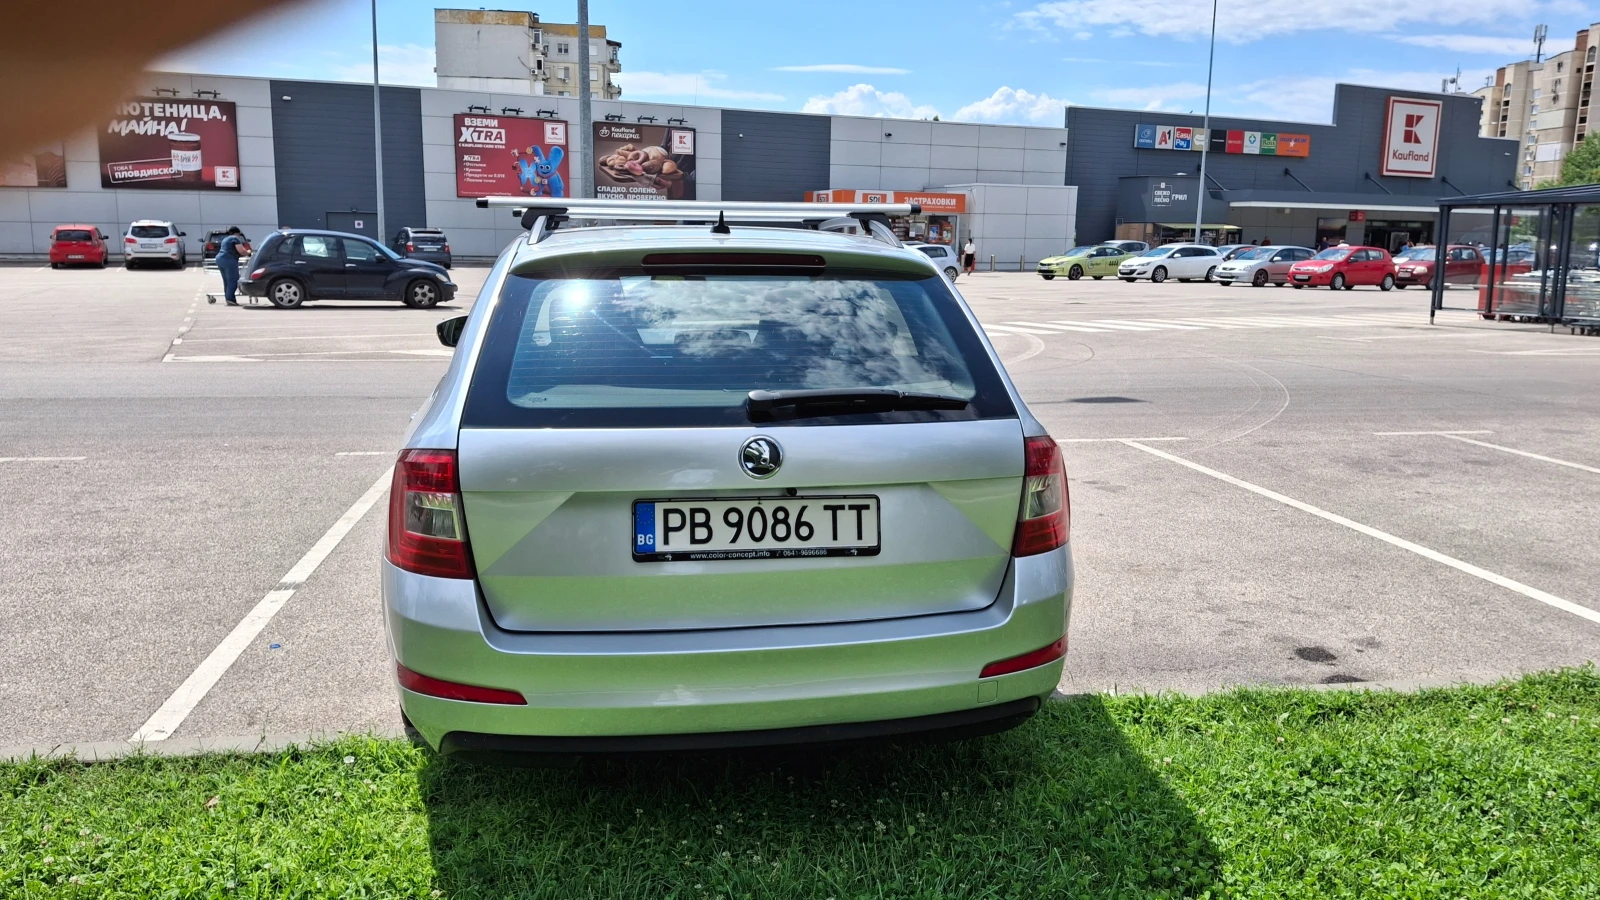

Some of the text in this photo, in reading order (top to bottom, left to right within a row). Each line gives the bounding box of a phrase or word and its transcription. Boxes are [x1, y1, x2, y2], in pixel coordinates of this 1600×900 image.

[107, 116, 187, 137] МАЙНА!
[464, 117, 498, 127] ВЗЕМИ
[459, 127, 504, 143] XTRA
[611, 132, 640, 140] пекарна
[1158, 129, 1172, 145] A1
[1176, 131, 1191, 140] Easy
[1175, 139, 1187, 147] Pay
[1392, 149, 1430, 162] Kaufland
[597, 185, 658, 194] СЛАДКО. СОЛЕНО.
[868, 195, 881, 203] SDI
[904, 196, 956, 206] ЗАСТРАХОВКИ
[1171, 193, 1188, 201] ГРИЛ
[663, 503, 871, 545] PB 9086 TT
[637, 533, 654, 546] BG
[690, 550, 771, 560] www.color-concept.info
